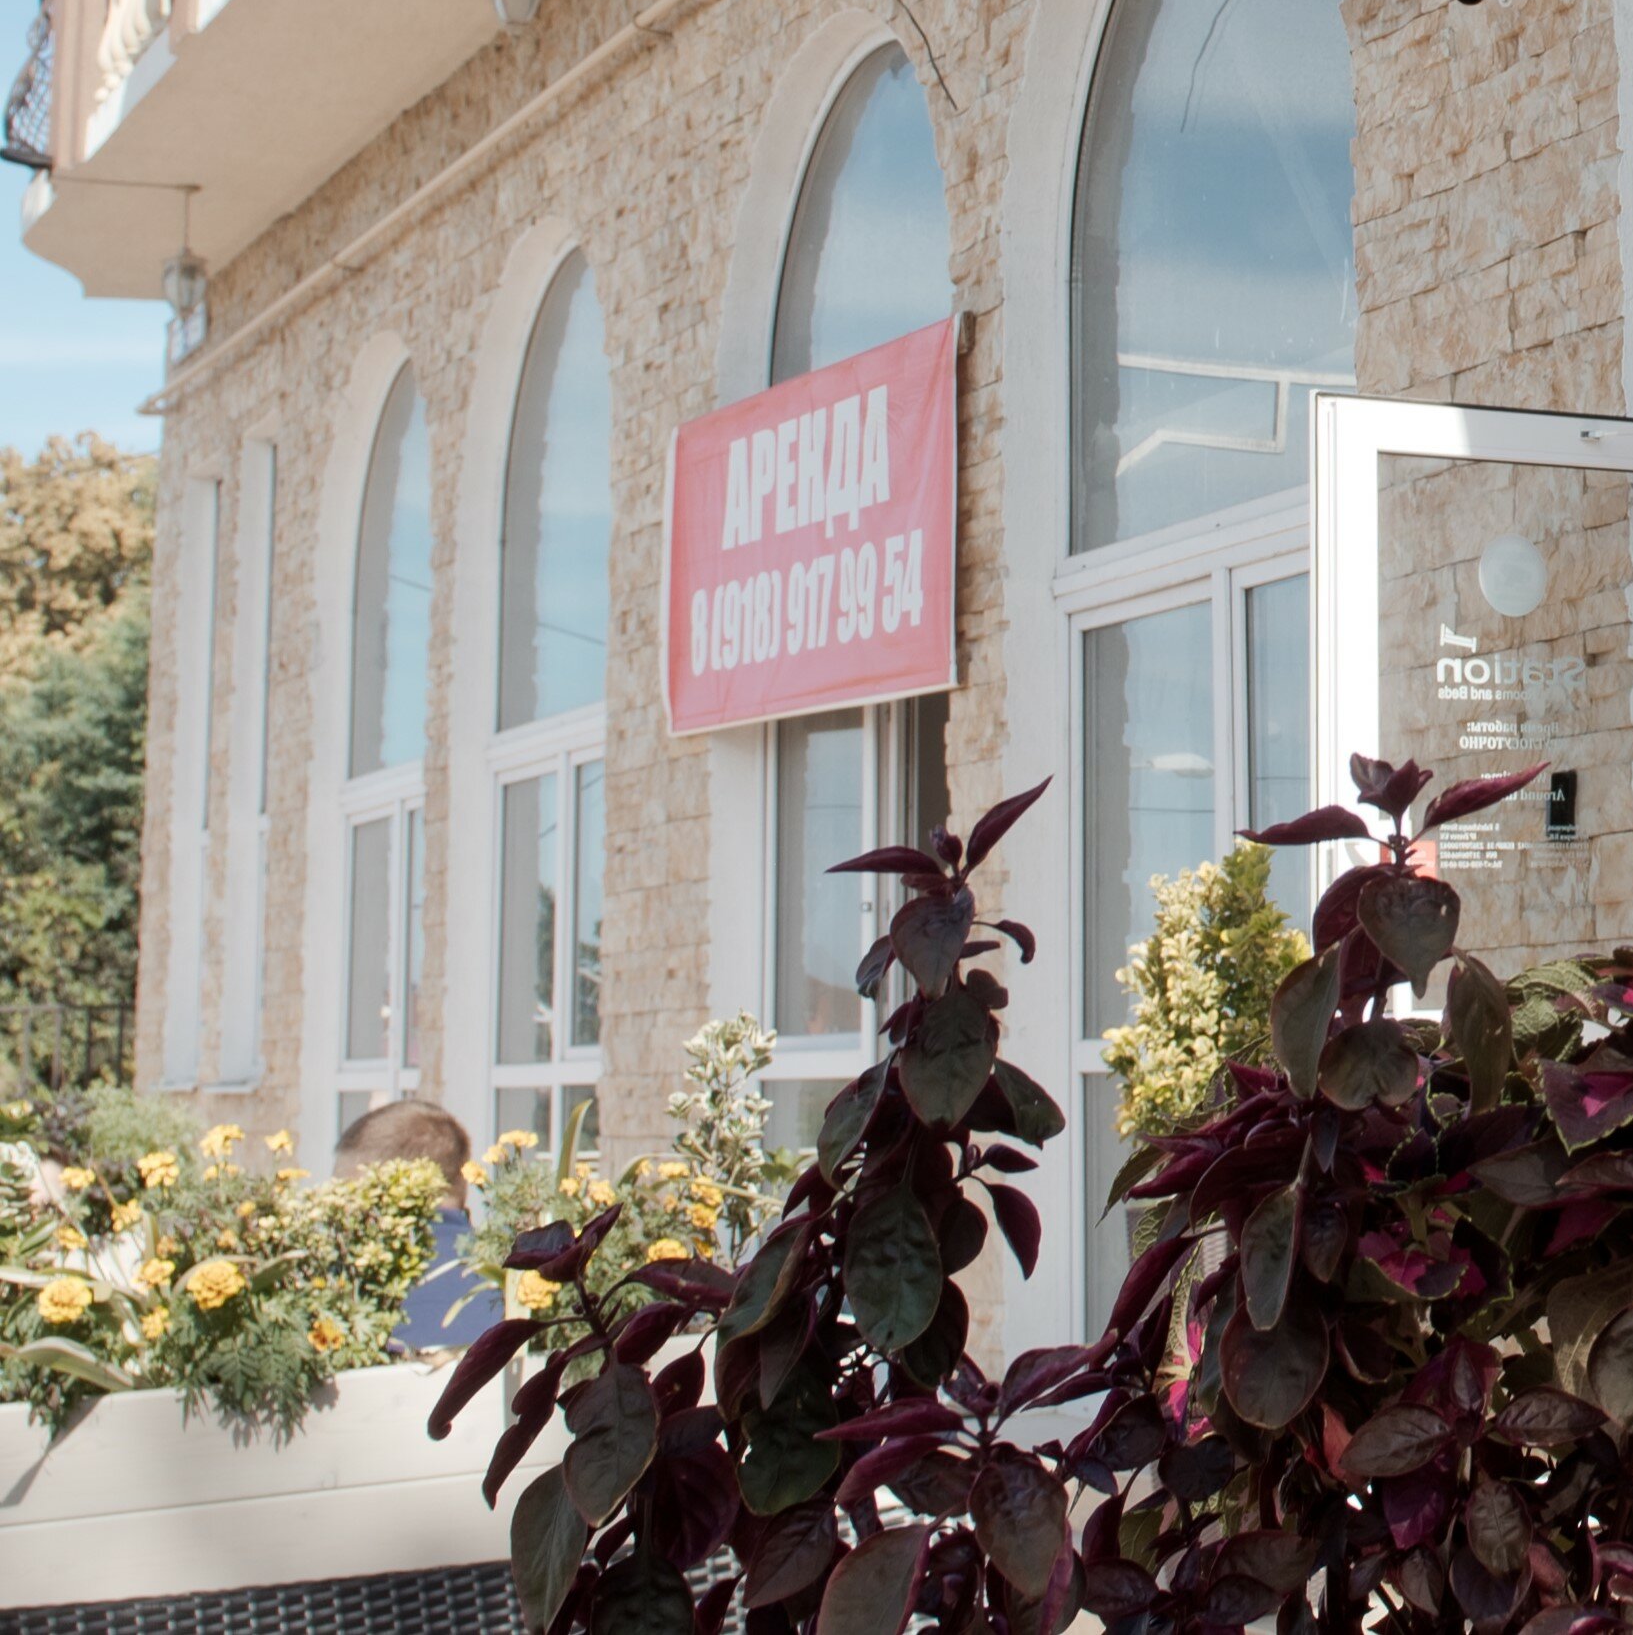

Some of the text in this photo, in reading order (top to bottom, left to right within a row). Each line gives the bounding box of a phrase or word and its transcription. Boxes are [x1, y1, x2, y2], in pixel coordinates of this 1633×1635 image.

[722, 385, 890, 550] АРЕНДА
[691, 528, 923, 677] 8 (918) 917 99 54
